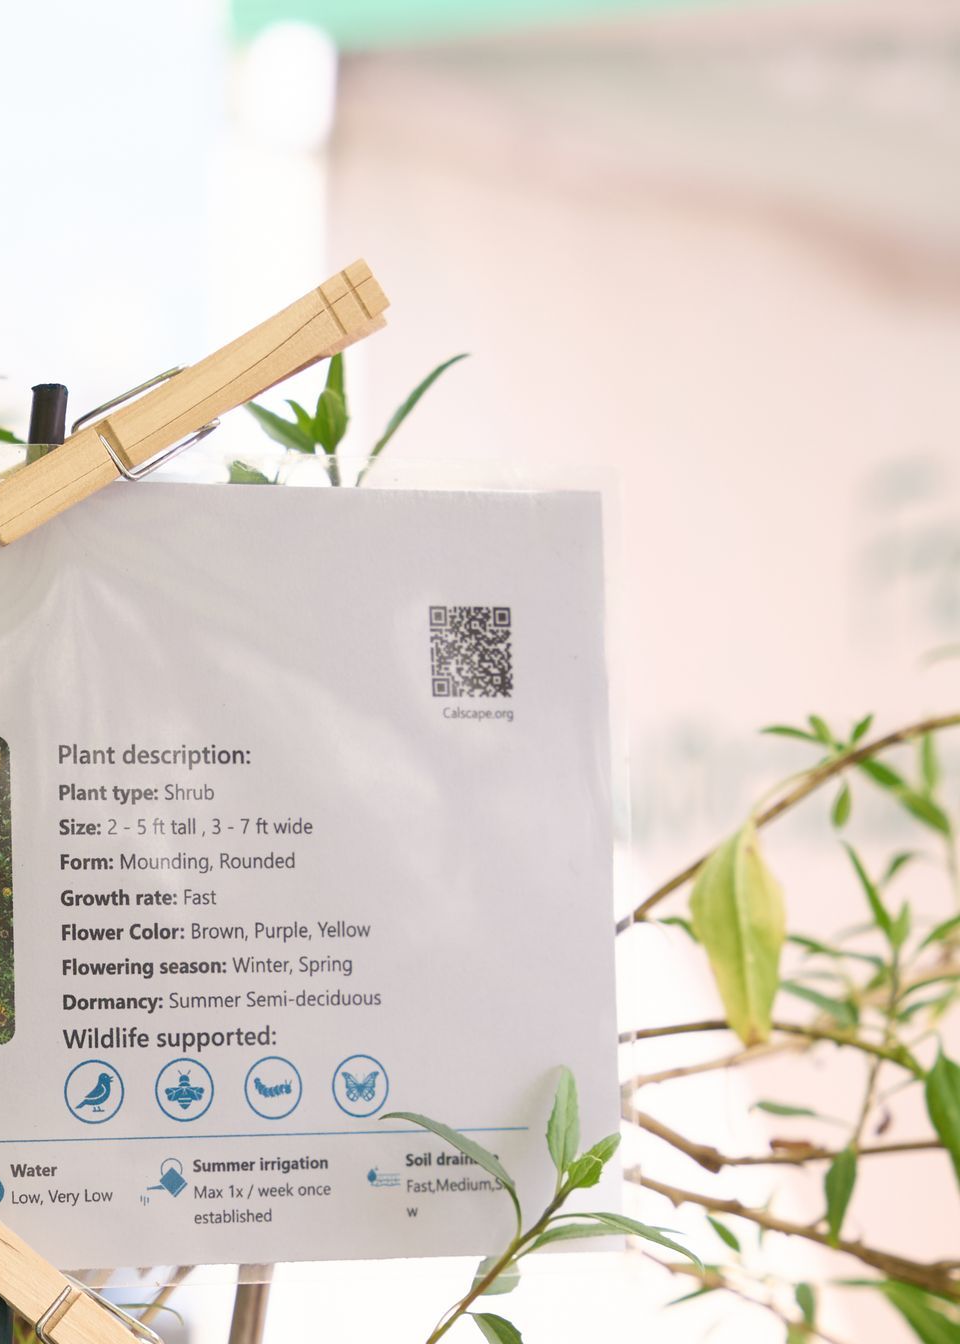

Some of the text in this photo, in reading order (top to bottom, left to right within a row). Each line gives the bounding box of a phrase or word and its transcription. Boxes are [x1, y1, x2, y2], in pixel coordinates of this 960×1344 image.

[442, 707, 514, 722] Calscape.org
[58, 744, 251, 769] Plant description:
[59, 784, 215, 804] Plant type: Shrub
[59, 820, 101, 835] Size:
[107, 820, 118, 834] 2
[137, 819, 146, 834] 5
[153, 818, 165, 834] ft
[171, 818, 196, 834] tall
[212, 819, 221, 834] 3
[240, 819, 250, 834] 7
[256, 818, 268, 834] ft
[273, 818, 313, 834] wide
[60, 852, 295, 873] Form: Mounding, Rounded
[60, 889, 217, 906] Growth rate: Fast
[61, 921, 370, 942] Flower Color: Brown, Purple, Yellow
[62, 956, 353, 978] Flowering season: Winter, Spring
[63, 990, 382, 1013] Dormancy: Summer Semi-deciduous
[63, 1025, 276, 1051] Wildlife supported:
[193, 1156, 328, 1173] Summer irrigation
[406, 1152, 499, 1166] Soil drain
[10, 1163, 57, 1179] Water
[11, 1188, 113, 1207] Low, Very Low
[194, 1183, 331, 1199] Max 1x / week once
[194, 1208, 272, 1224] established
[407, 1208, 418, 1217] w
